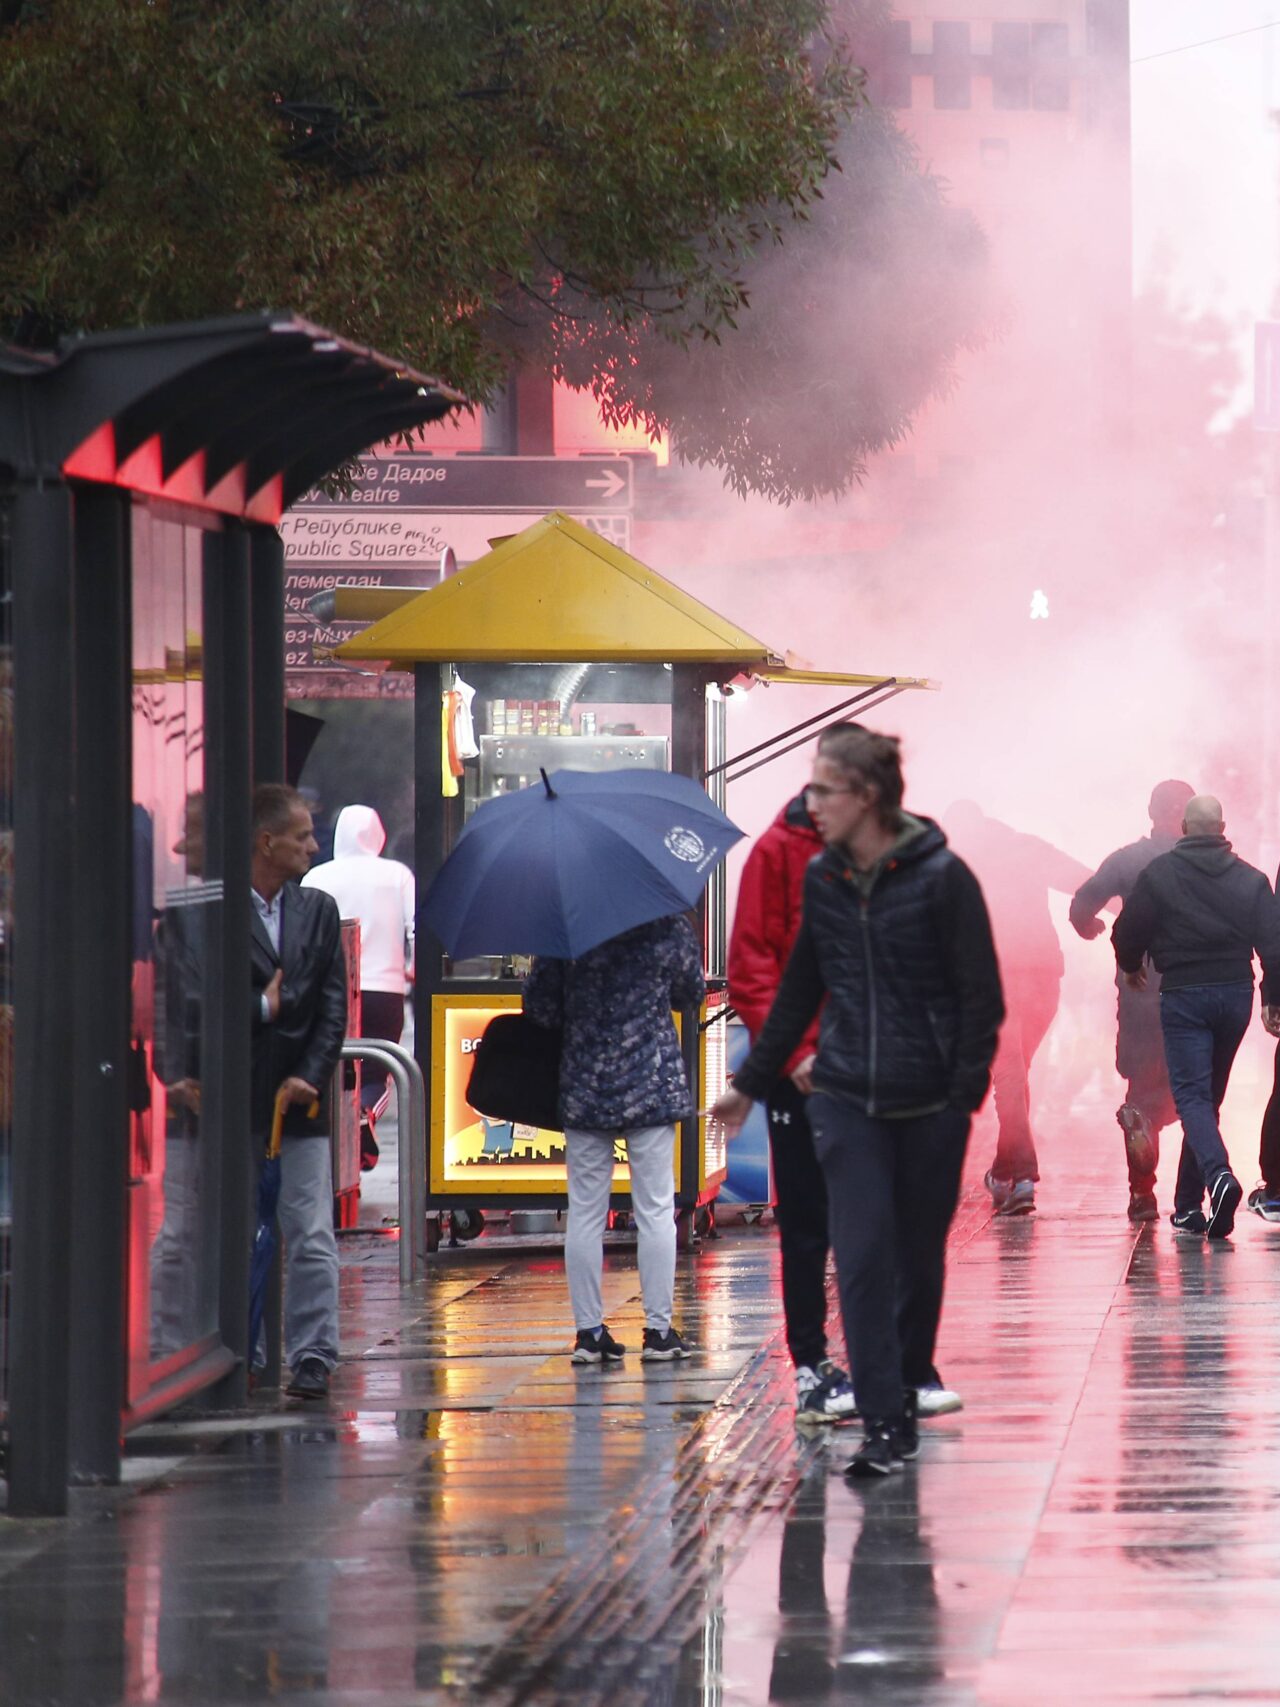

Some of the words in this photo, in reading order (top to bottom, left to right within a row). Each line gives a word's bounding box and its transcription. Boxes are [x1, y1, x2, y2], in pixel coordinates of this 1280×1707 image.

[382, 463, 447, 483] Дадов
[285, 540, 342, 558] public
[350, 540, 417, 561] Square
[285, 575, 381, 589] лемегдан
